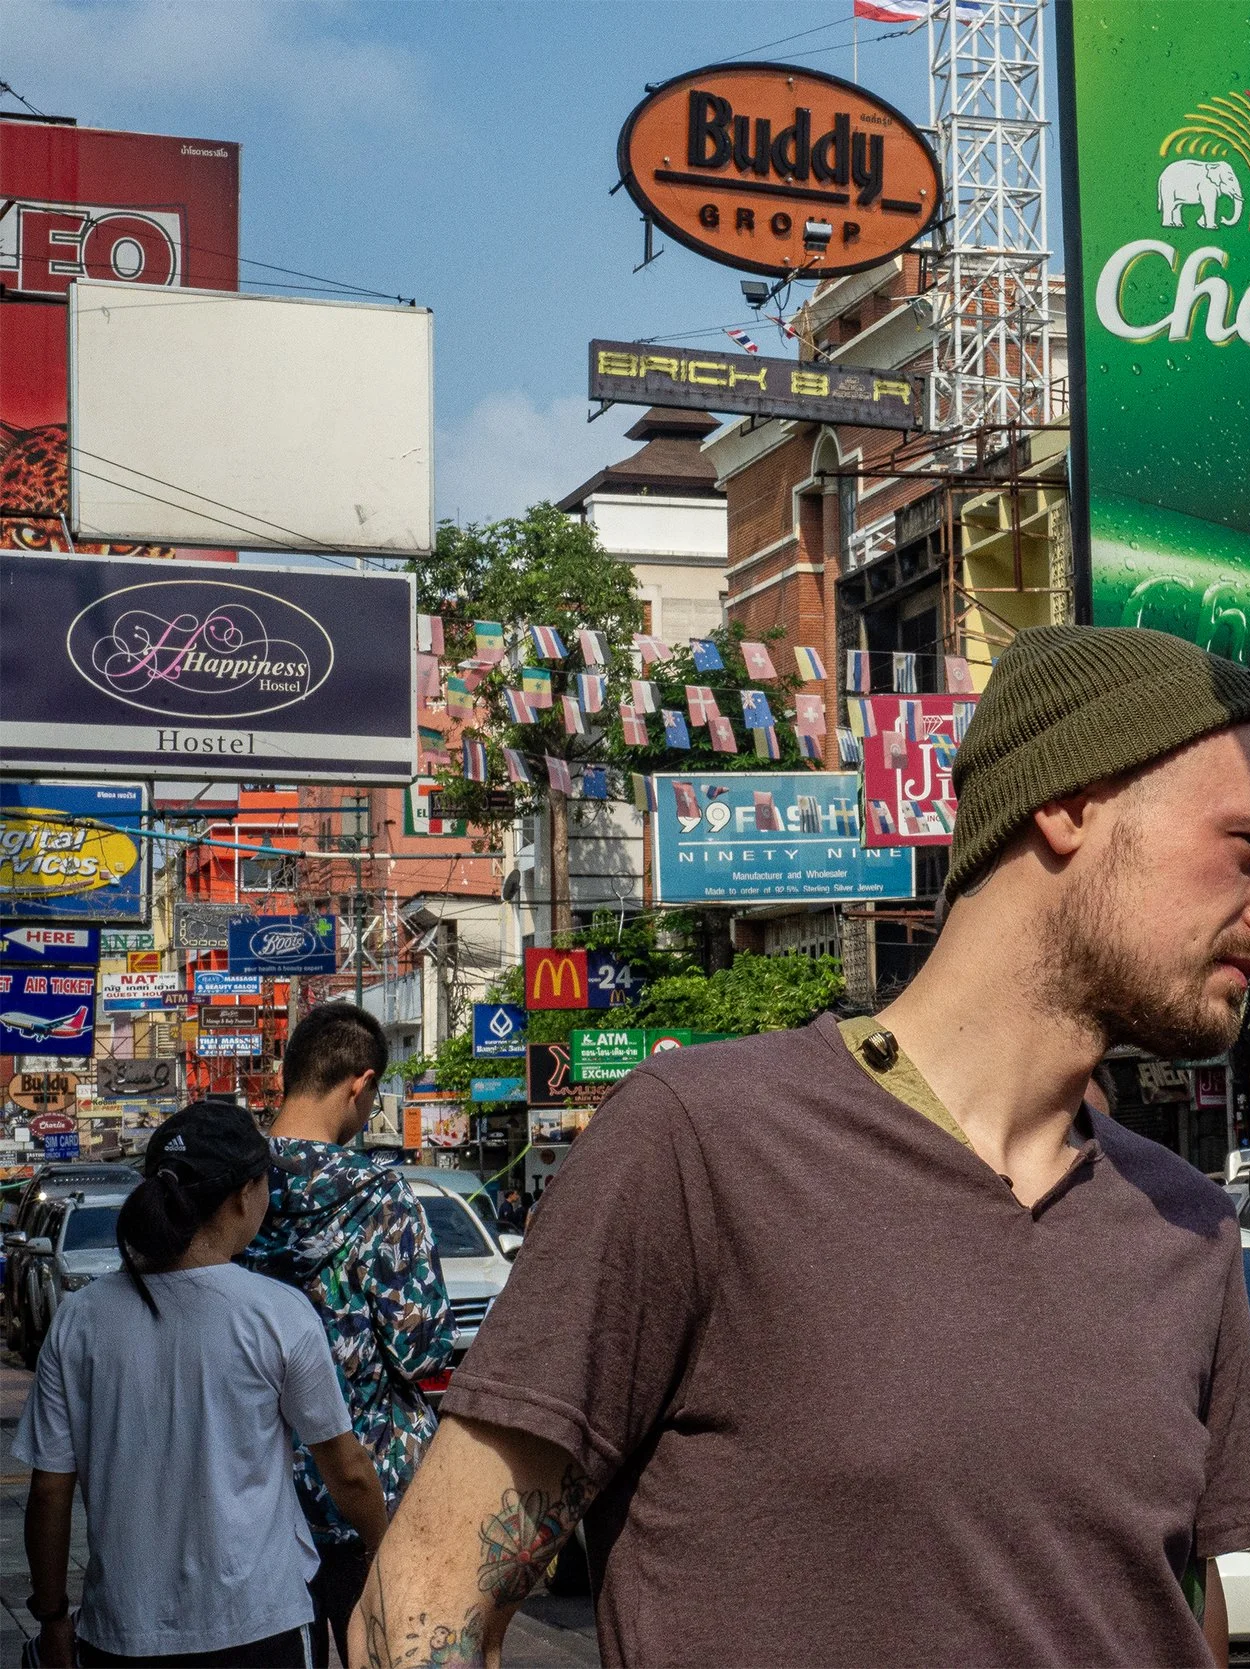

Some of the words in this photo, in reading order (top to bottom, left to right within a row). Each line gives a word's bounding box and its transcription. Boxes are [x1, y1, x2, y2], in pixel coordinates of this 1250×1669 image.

[687, 89, 885, 207] Buddy
[700, 203, 861, 243] GROP
[0, 203, 179, 293] EO
[597, 351, 768, 392] BRICK
[180, 651, 308, 679] Happiness
[259, 678, 302, 693] Hostel
[156, 730, 257, 756] Hostel
[679, 849, 799, 863] NINETY
[828, 847, 902, 859] NINE
[732, 871, 783, 881] Manufacturer
[787, 870, 802, 880] and
[806, 869, 848, 879] Wholesaler
[705, 887, 725, 896] Made
[729, 887, 736, 895] to
[741, 886, 760, 895] order
[803, 884, 830, 894] Sterling
[834, 883, 853, 893] Silver
[857, 883, 884, 893] Jewelry
[26, 931, 76, 944] HERE
[258, 931, 306, 955] Boots
[24, 976, 48, 994] AIR
[51, 977, 95, 995] TICKET
[121, 975, 157, 984] NAT
[598, 965, 633, 989] 24
[165, 995, 188, 1004] ATM
[597, 1032, 628, 1045] ATM
[45, 1137, 58, 1149] SIM
[59, 1136, 79, 1148] CARD
